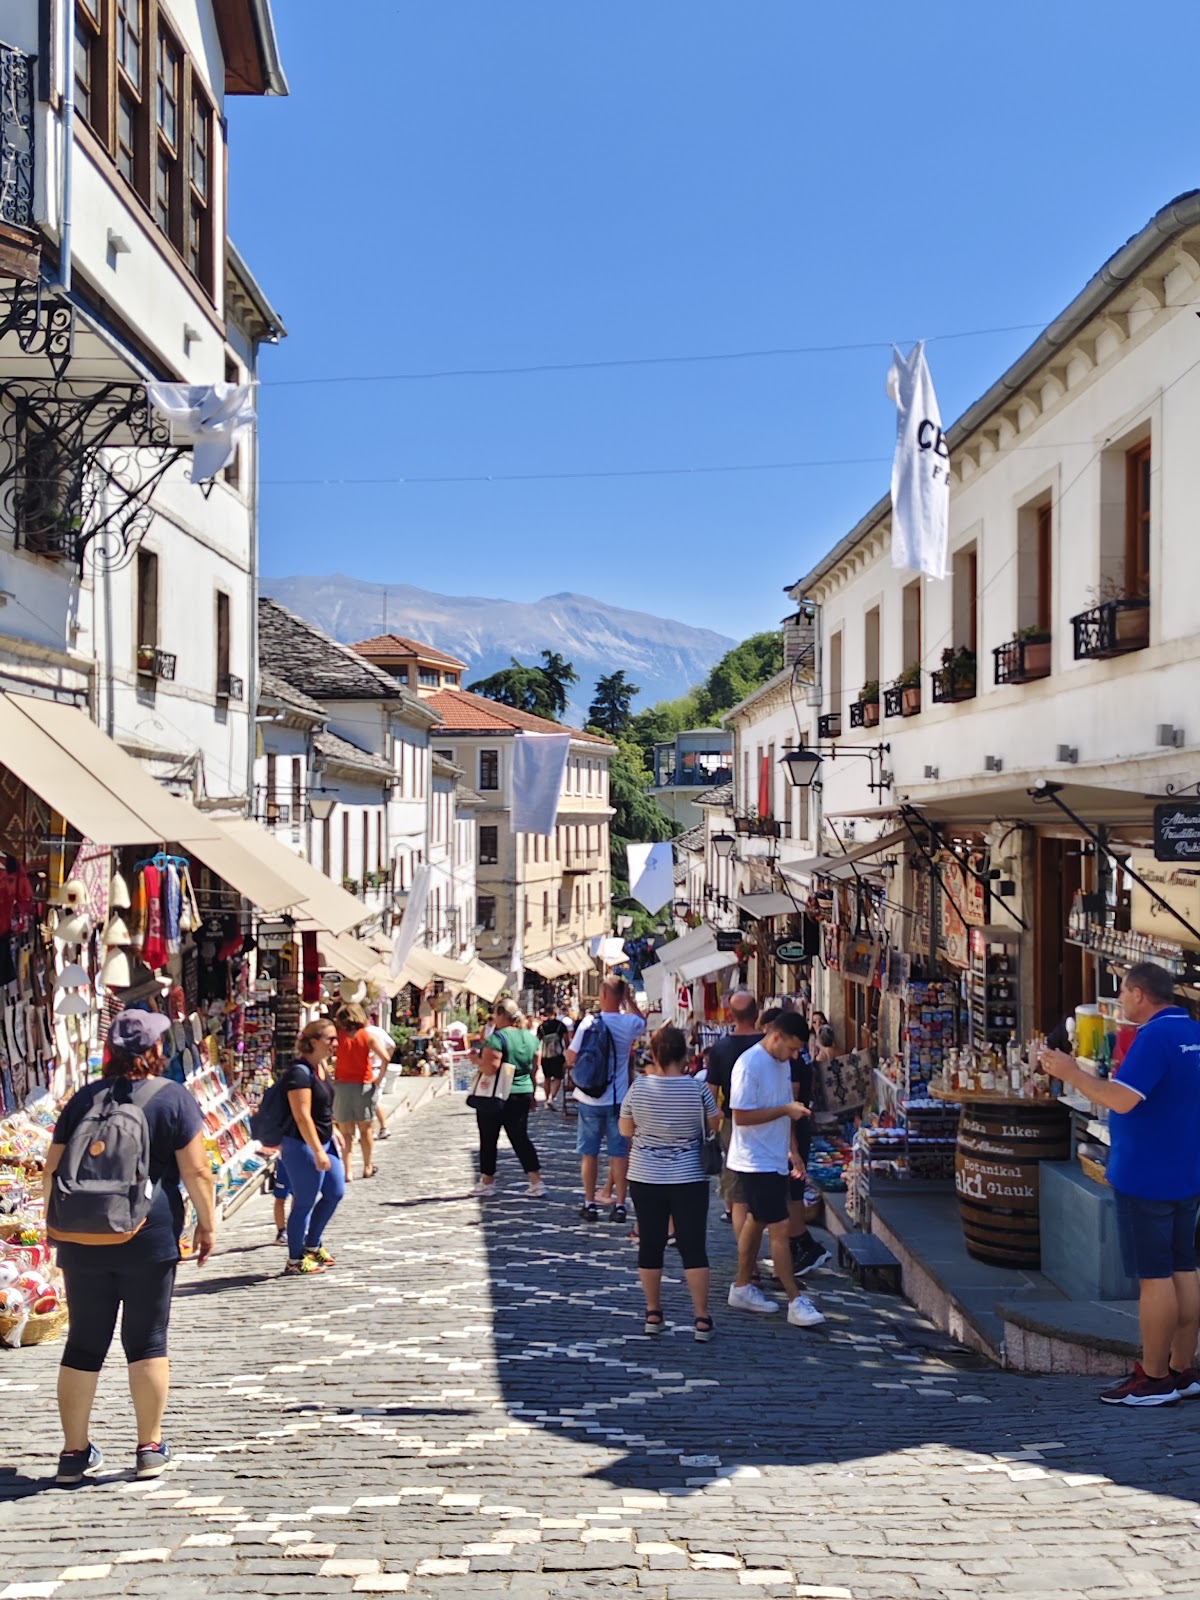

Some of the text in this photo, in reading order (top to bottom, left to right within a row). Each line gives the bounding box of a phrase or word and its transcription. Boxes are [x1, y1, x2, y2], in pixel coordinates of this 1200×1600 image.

[1001, 1125, 1040, 1138] Liker
[964, 1159, 1022, 1177] Botanikal
[987, 1181, 1034, 1197] Glauk
